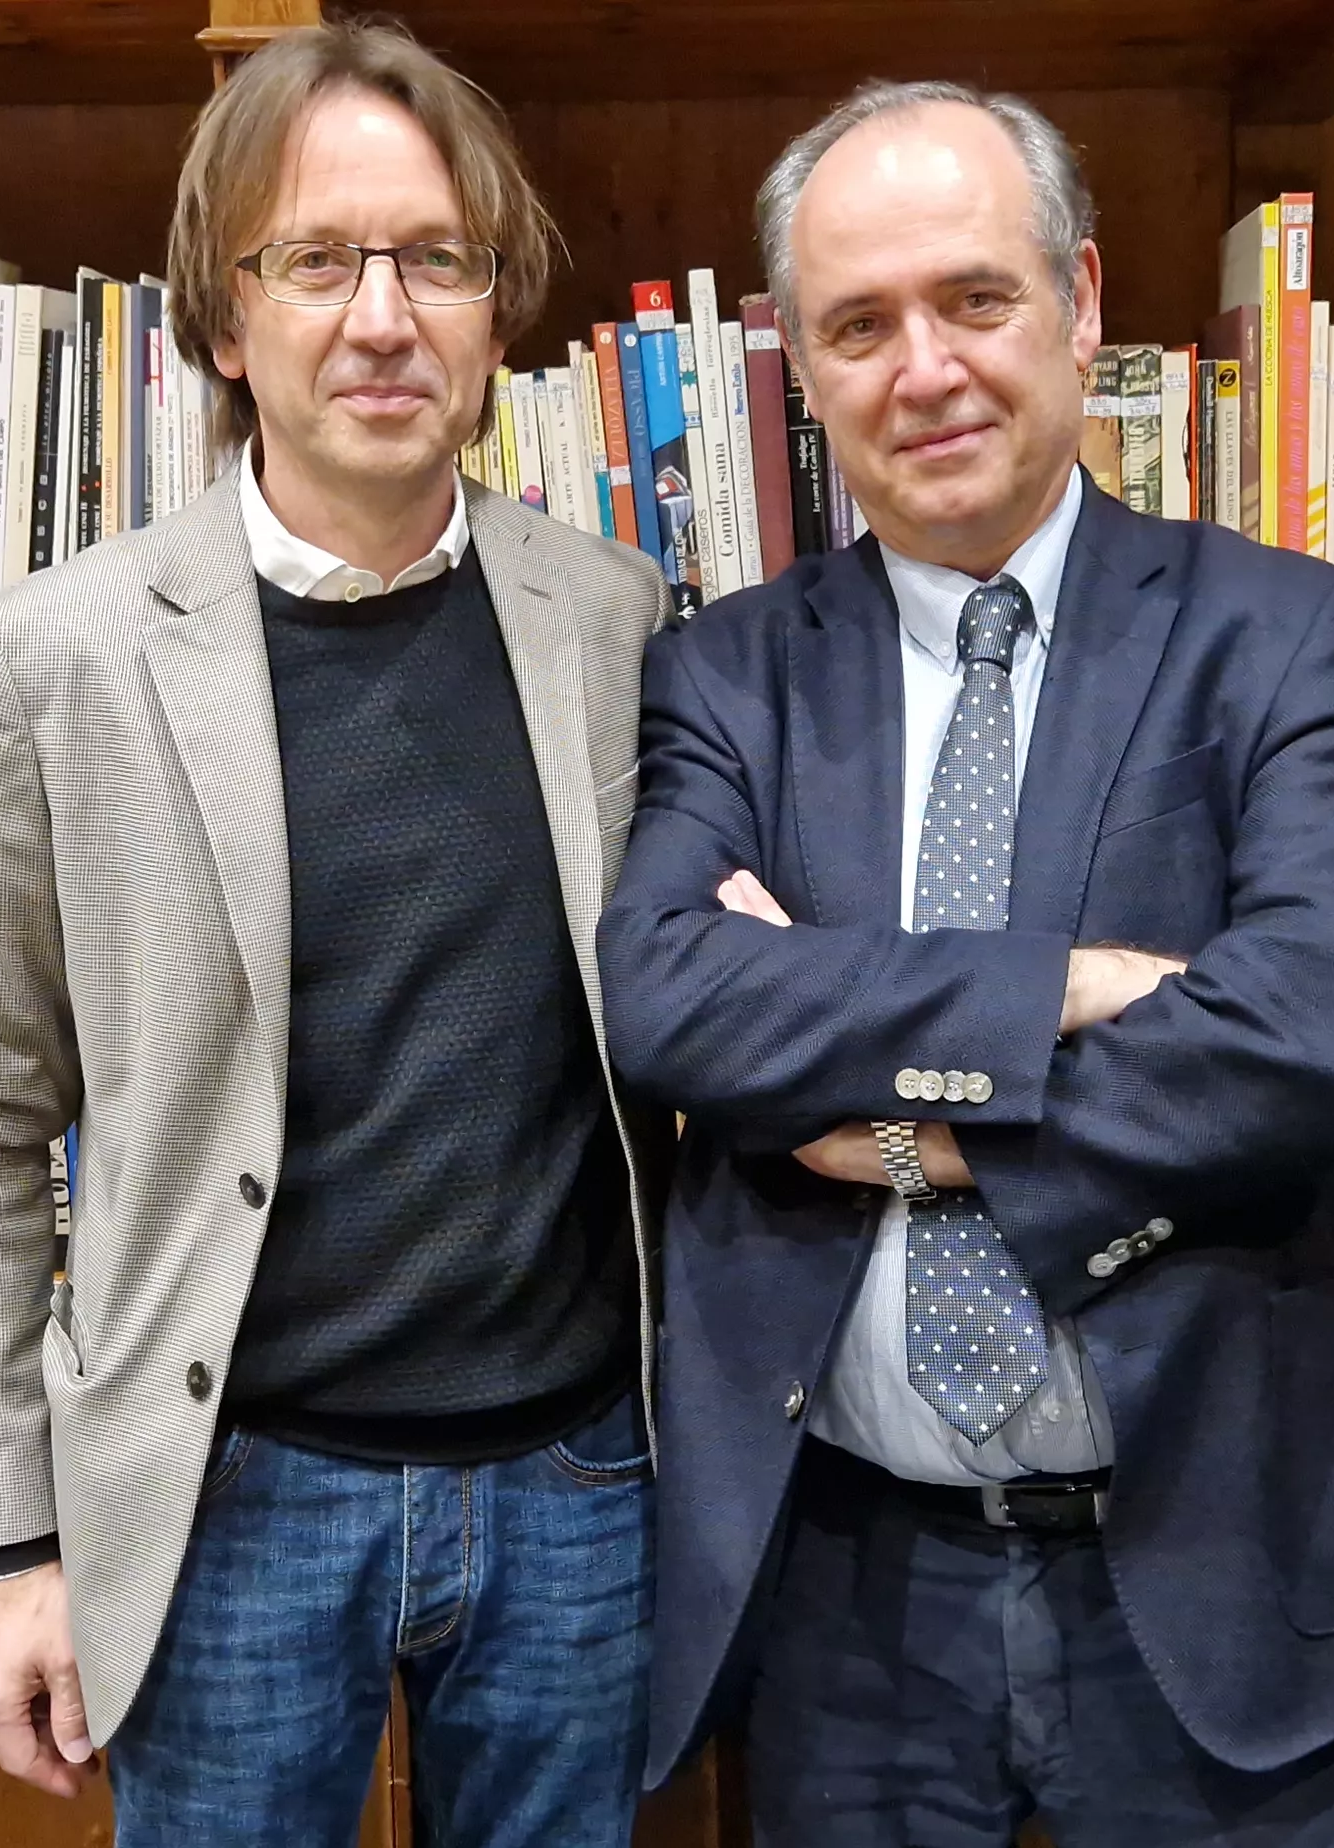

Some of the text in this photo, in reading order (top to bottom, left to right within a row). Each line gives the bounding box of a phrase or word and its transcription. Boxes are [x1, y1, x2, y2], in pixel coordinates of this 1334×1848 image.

[1292, 231, 1304, 283] Altoaragón
[650, 290, 661, 306] 6
[1264, 289, 1274, 386] LA COCINA DE HUESCA
[626, 368, 645, 436] PICASSO
[729, 335, 753, 518] de la DECORACION Nuevo Estilo 1995
[798, 434, 808, 468] Trafalgar
[805, 432, 819, 480] de Carlos IV
[1224, 410, 1234, 521] LAS LLAVES DEL REINO
[714, 442, 733, 557] Comida sana
[694, 508, 711, 562] caseros
